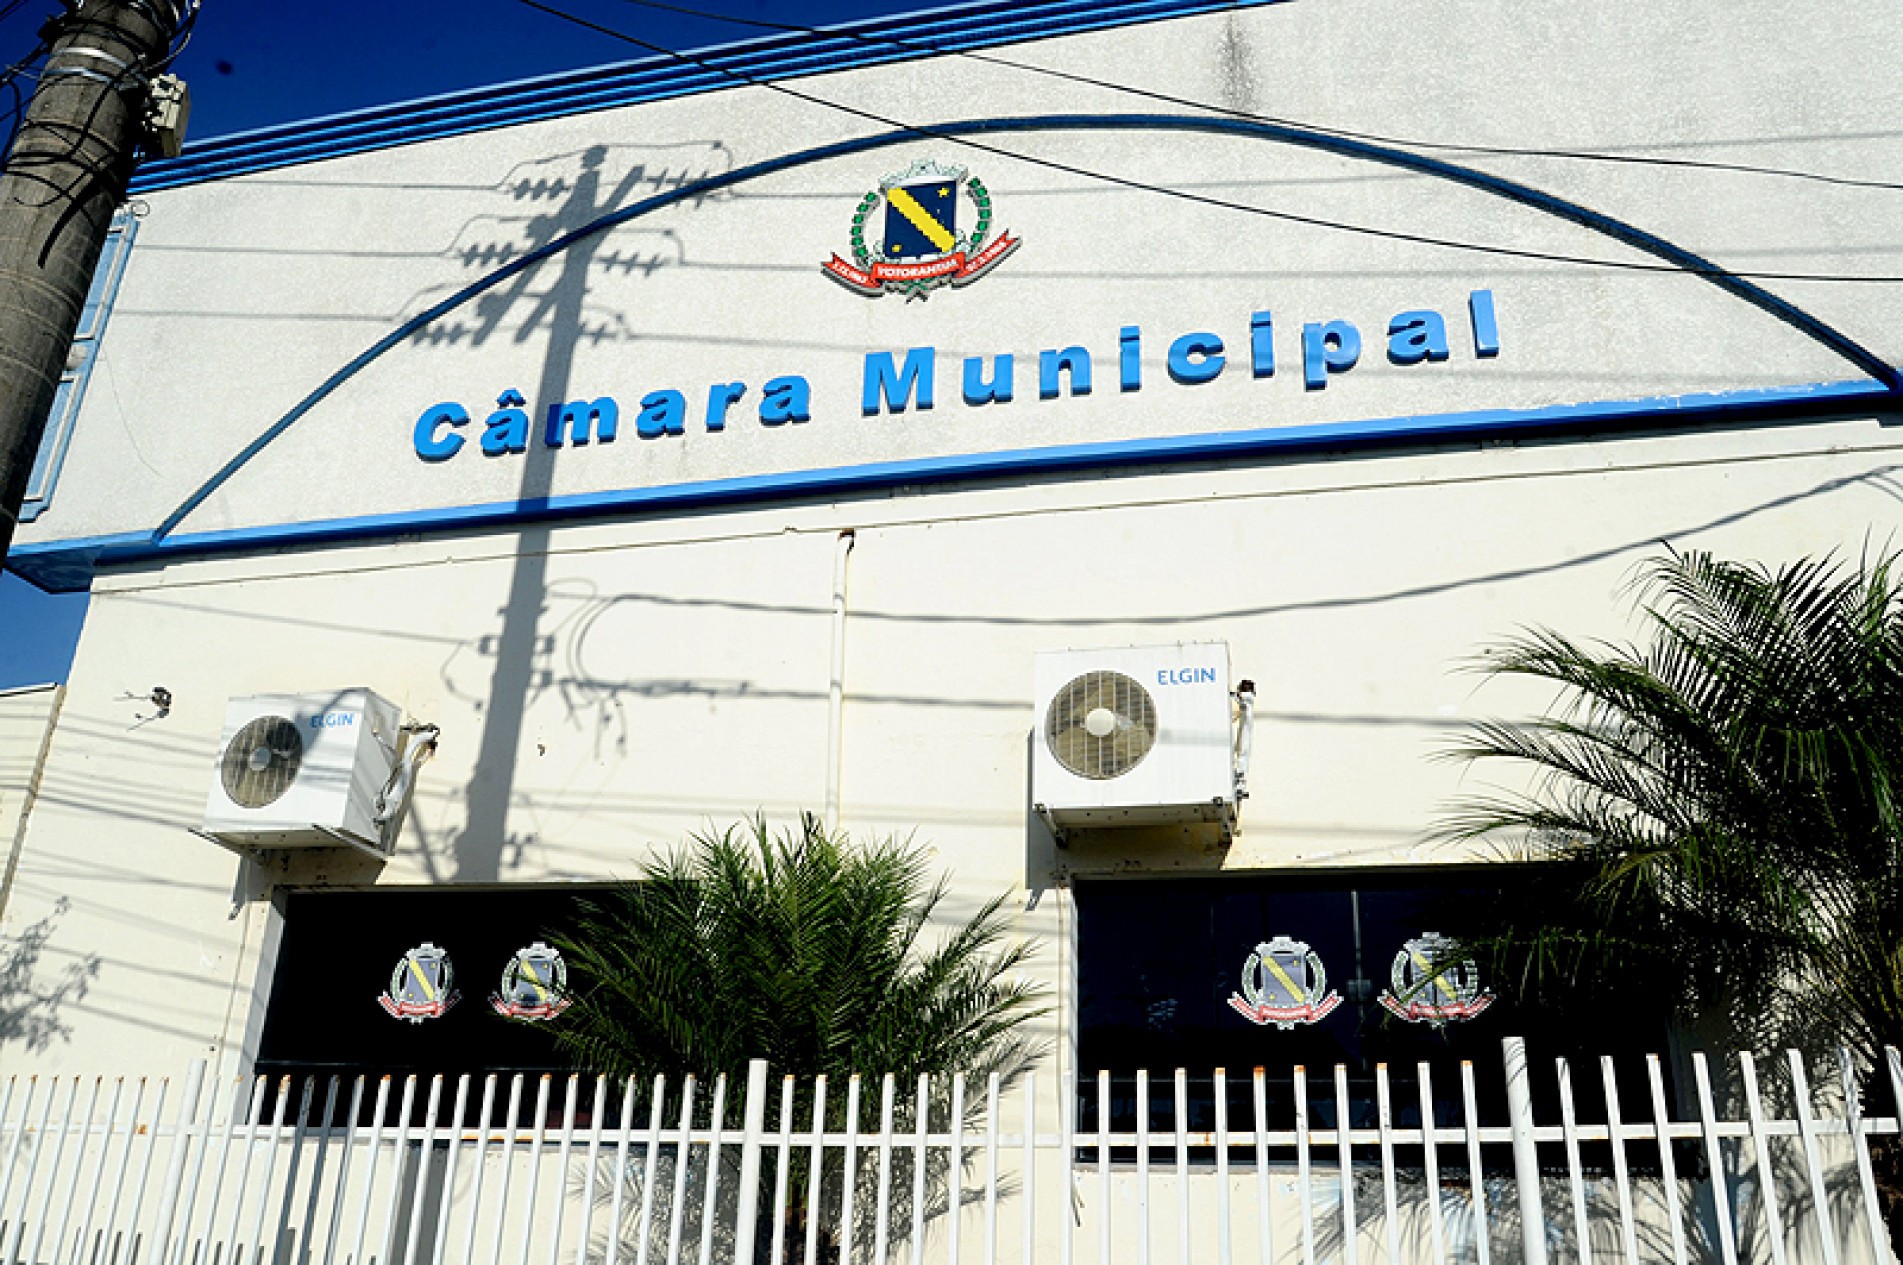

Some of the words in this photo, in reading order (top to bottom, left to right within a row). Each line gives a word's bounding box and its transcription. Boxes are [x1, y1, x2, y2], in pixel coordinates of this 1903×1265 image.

[413, 375, 811, 462] Câmara
[862, 289, 1500, 416] Municipal
[1158, 667, 1216, 685] ELGIN
[311, 713, 353, 728] ELGIN
